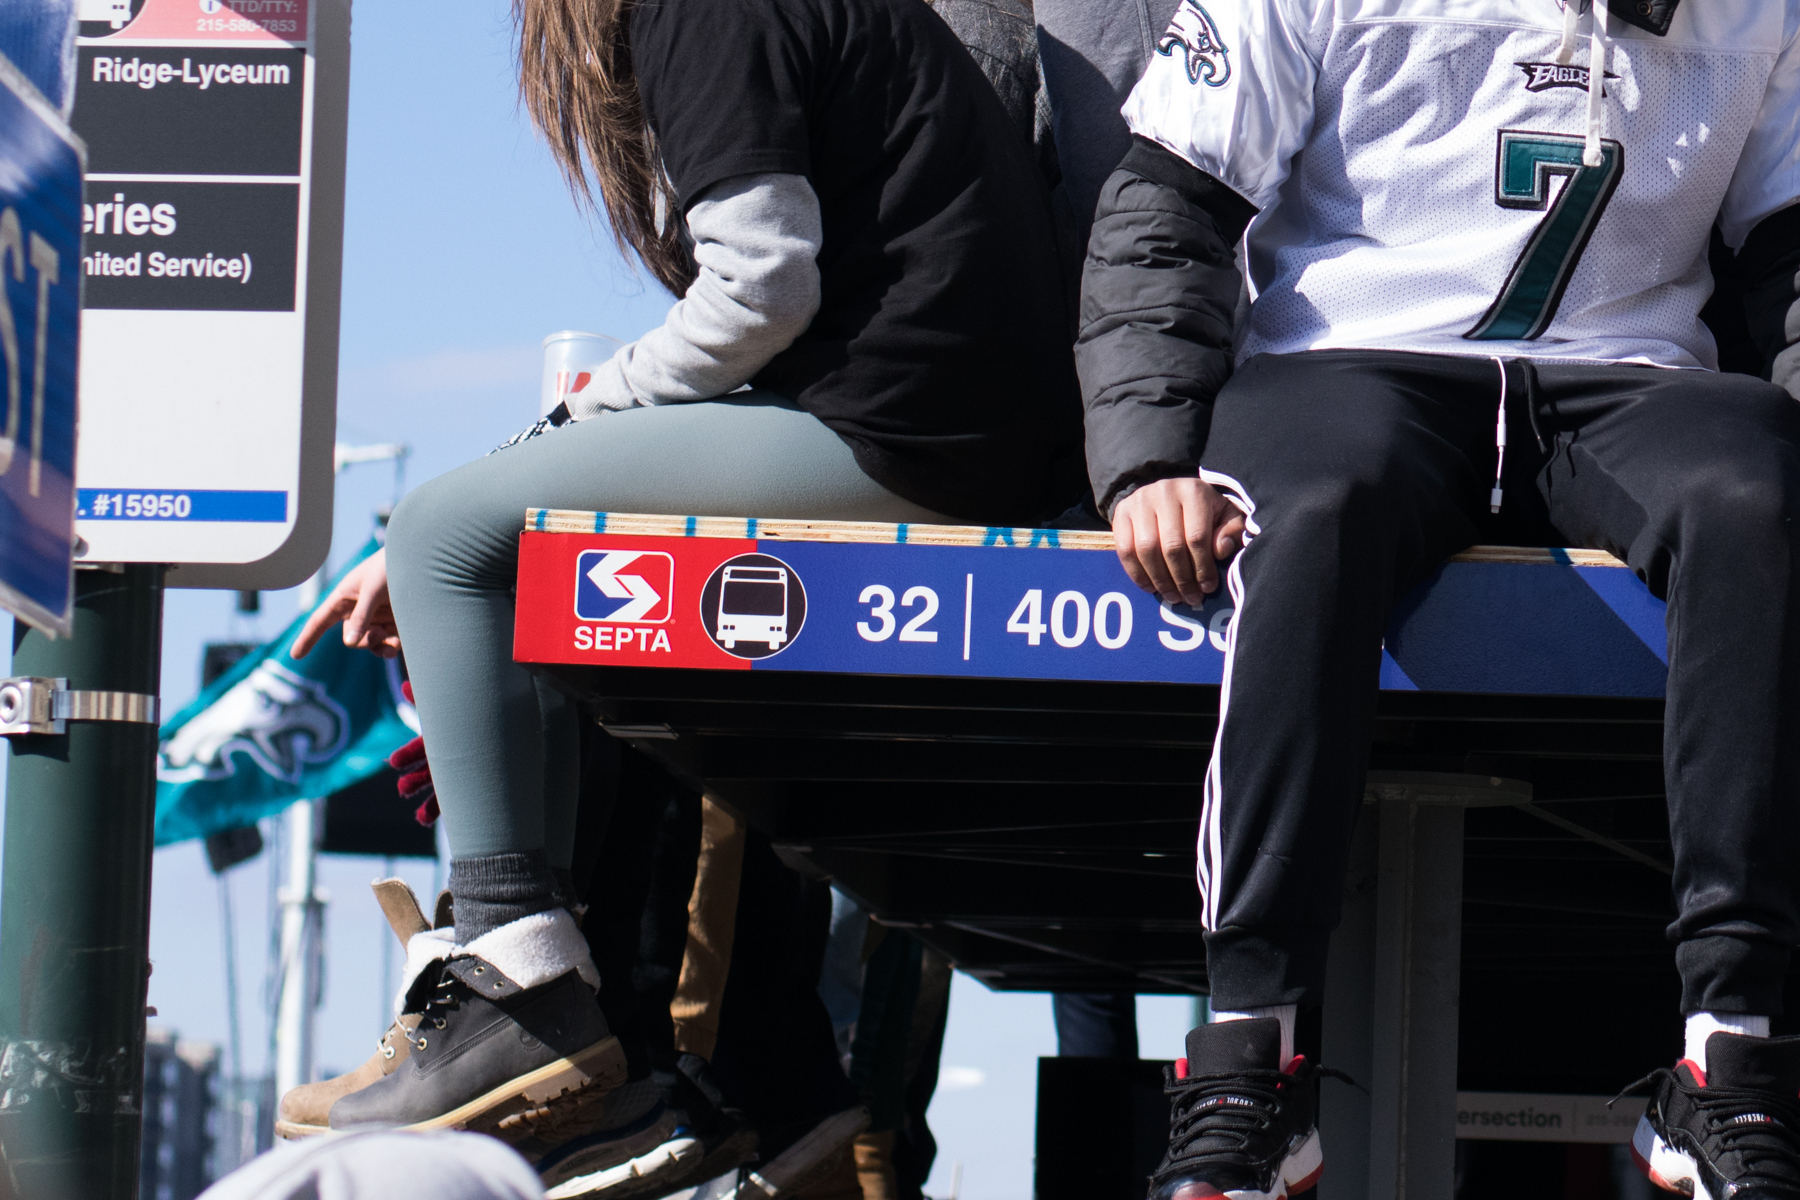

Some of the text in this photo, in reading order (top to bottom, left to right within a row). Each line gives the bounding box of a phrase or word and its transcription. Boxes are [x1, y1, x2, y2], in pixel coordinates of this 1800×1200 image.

[227, 0, 298, 14] TTD/TTY:
[196, 18, 297, 33] 215-580-7853
[93, 56, 290, 90] Ridge-Lyceum
[1462, 128, 1625, 341] 7
[147, 251, 252, 284] Service)
[92, 493, 192, 518] #15950
[856, 584, 940, 643] 32
[1006, 588, 1133, 650] 400
[573, 625, 672, 653] SEPTA
[1456, 1106, 1563, 1128] ersection
